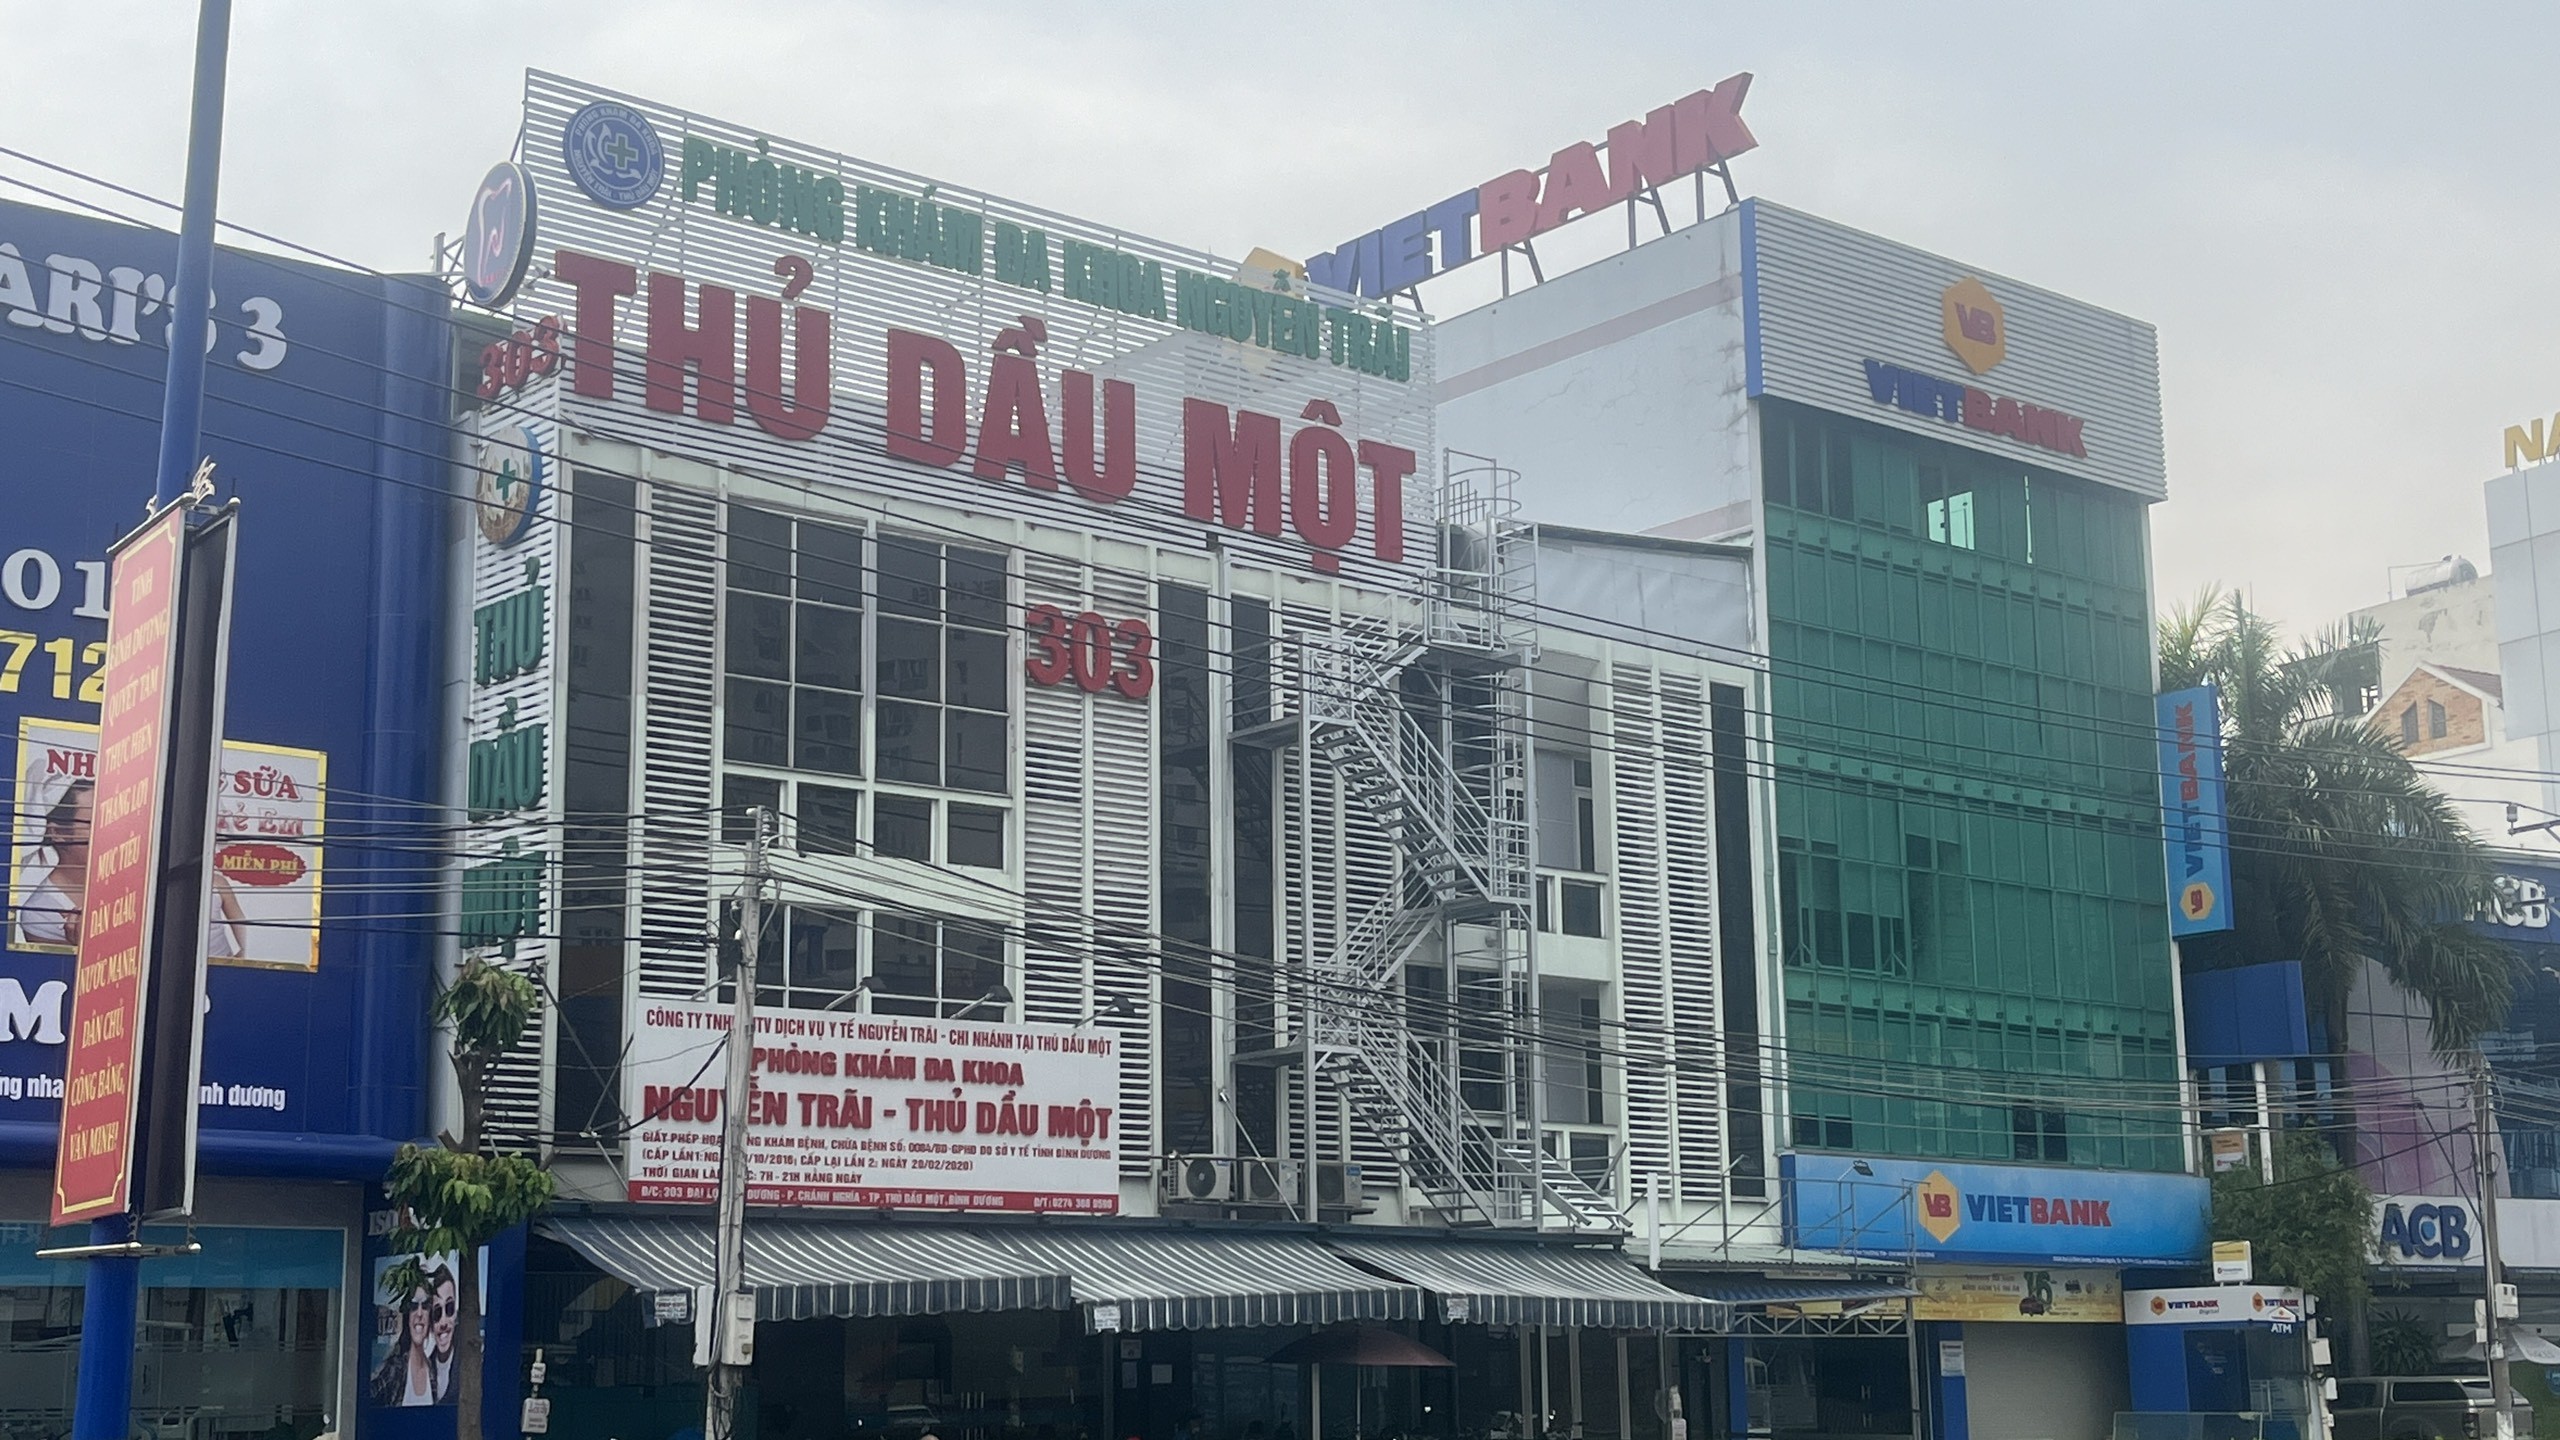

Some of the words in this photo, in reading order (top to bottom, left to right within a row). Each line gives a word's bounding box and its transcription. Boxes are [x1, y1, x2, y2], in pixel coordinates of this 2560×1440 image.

[1305, 72, 1759, 302] VIETBANK
[682, 136, 844, 244] PHÒNG
[856, 184, 983, 276] KHÁM
[995, 222, 1051, 295] ĐA
[1063, 239, 1168, 322] KHOA
[1176, 268, 1319, 361] NGUYỄN
[237, 296, 287, 371] 3
[1954, 302, 1996, 345] VB
[477, 315, 562, 401] 303
[555, 249, 832, 442] THỦ
[886, 314, 1137, 505] DẦU
[1183, 397, 1417, 575] MỘT
[1863, 358, 2088, 459] VIETBANK
[473, 555, 544, 687] THỦ
[1025, 604, 1153, 699] 303
[234, 765, 298, 799] SỮA
[468, 696, 547, 823] DẦU
[2175, 702, 2204, 878] VIETBANK
[222, 850, 265, 870] MIỄN
[270, 858, 298, 875] PHÍ
[2463, 876, 2550, 928] CB
[646, 1005, 683, 1028] CÔNG
[687, 1011, 700, 1029] TY
[775, 1017, 805, 1038] DỊCH
[808, 1020, 825, 1041] VỤ
[829, 1022, 838, 1038] Y
[840, 1017, 857, 1039] TẾ
[858, 1019, 908, 1042] NGUYỄN
[910, 1024, 938, 1044] TRÃI
[949, 1029, 969, 1046] CHI
[973, 1028, 1013, 1049] NHÁNH
[1016, 1034, 1034, 1054] TẠI
[1036, 1032, 1058, 1052] THỦ
[1087, 1036, 1112, 1058] MỘT
[27, 1074, 64, 1098] nha
[751, 1042, 837, 1076] PHÒNG
[844, 1048, 916, 1081] KHÁM
[924, 1057, 955, 1082] ĐA
[962, 1059, 1024, 1087] KHOA
[228, 1085, 285, 1111] dương
[797, 1088, 872, 1130] TRÃI
[905, 1087, 966, 1134] THỦ
[1048, 1098, 1112, 1147] MỘT
[642, 1128, 668, 1144] GIẤY
[670, 1130, 699, 1145] PHÉP
[764, 1135, 795, 1149] KHÁM
[1010, 1148, 1016, 1156] Y
[672, 1167, 699, 1178] GIAN
[760, 1171, 773, 1182] 7H
[1923, 1193, 1951, 1218] VB
[1966, 1193, 2112, 1227] VIETBANK
[2380, 1203, 2471, 1259] ACB
[2168, 1300, 2218, 1309] VIETBANK
[2271, 1323, 2292, 1334] ATM
